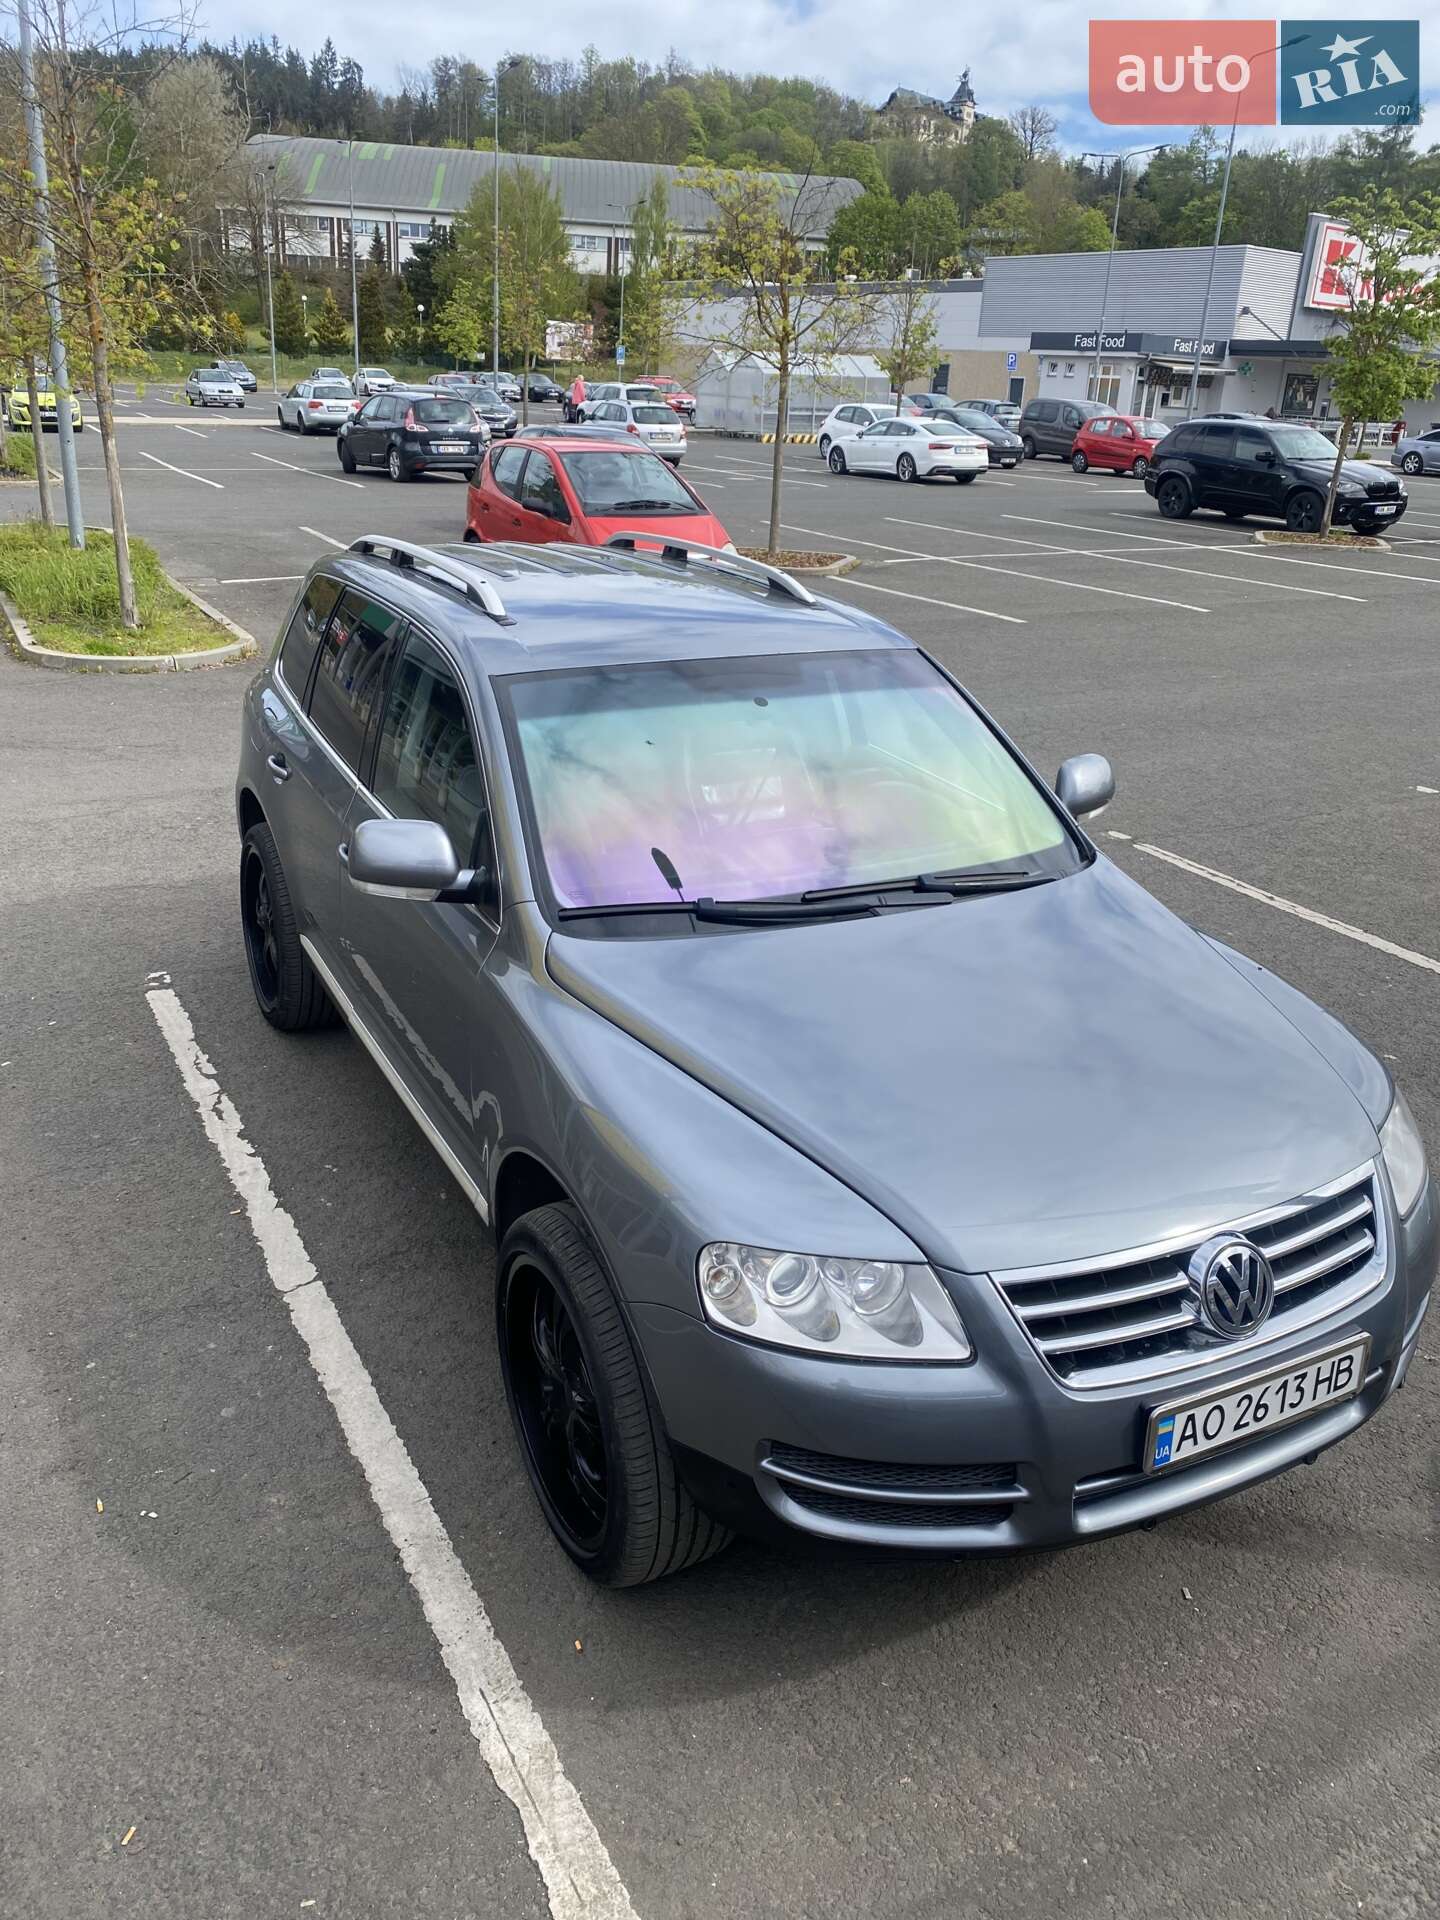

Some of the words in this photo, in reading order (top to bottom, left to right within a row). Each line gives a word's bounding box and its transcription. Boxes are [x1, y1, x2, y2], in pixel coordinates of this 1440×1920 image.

[1074, 334, 1097, 348] Fast
[1099, 335, 1126, 348] Food
[1173, 338, 1193, 353] Fast
[1008, 354, 1016, 366] P
[1175, 1404, 1226, 1453] AO
[1232, 1370, 1308, 1432] 2613
[1312, 1354, 1355, 1401] HB
[1154, 1445, 1171, 1461] UA
